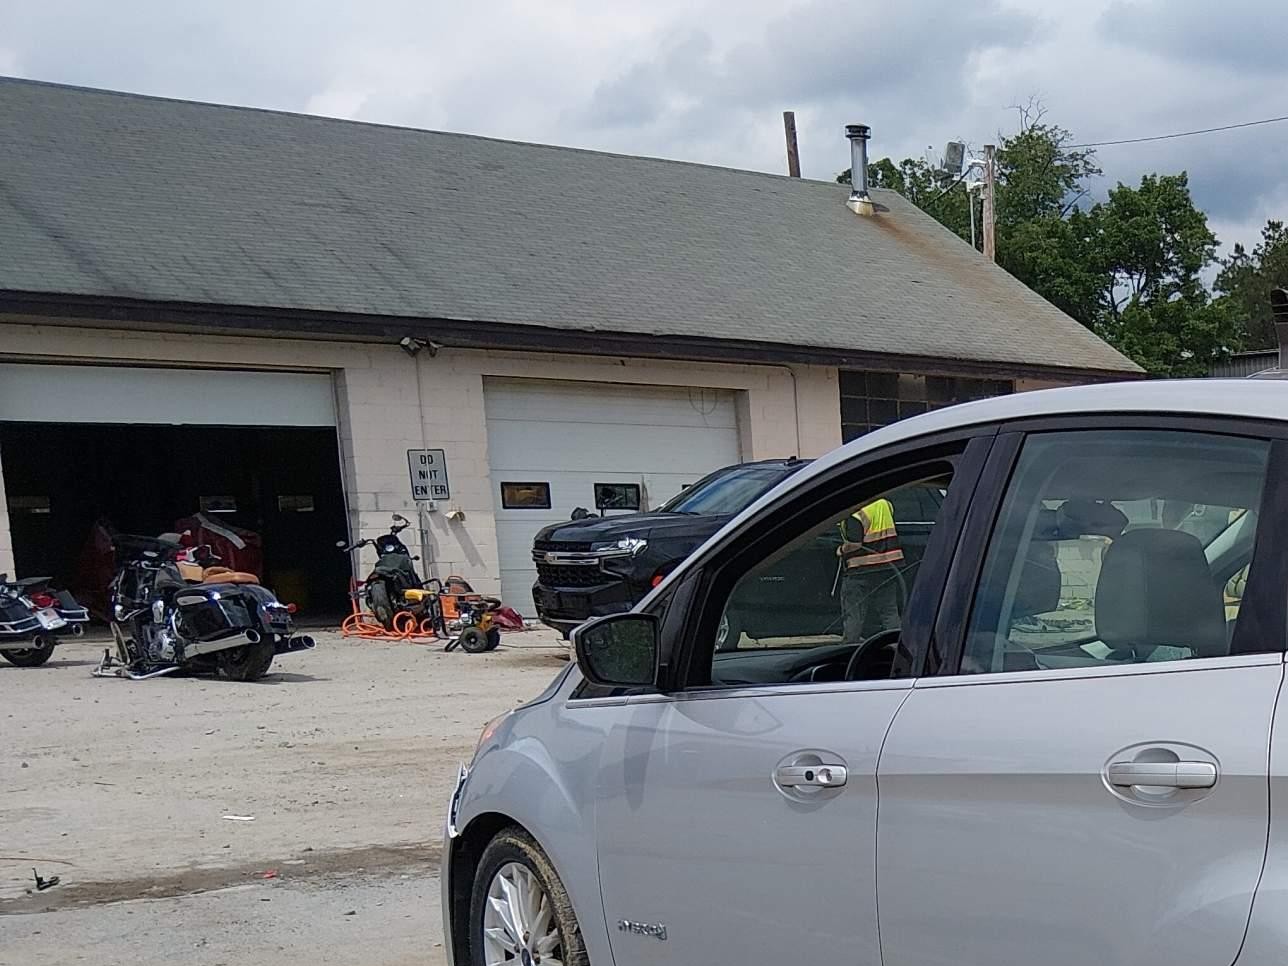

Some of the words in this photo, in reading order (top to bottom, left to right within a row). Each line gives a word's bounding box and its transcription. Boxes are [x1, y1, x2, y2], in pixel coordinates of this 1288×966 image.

[419, 454, 434, 465] DO
[418, 469, 438, 480] NOT
[414, 484, 447, 496] ENTER
